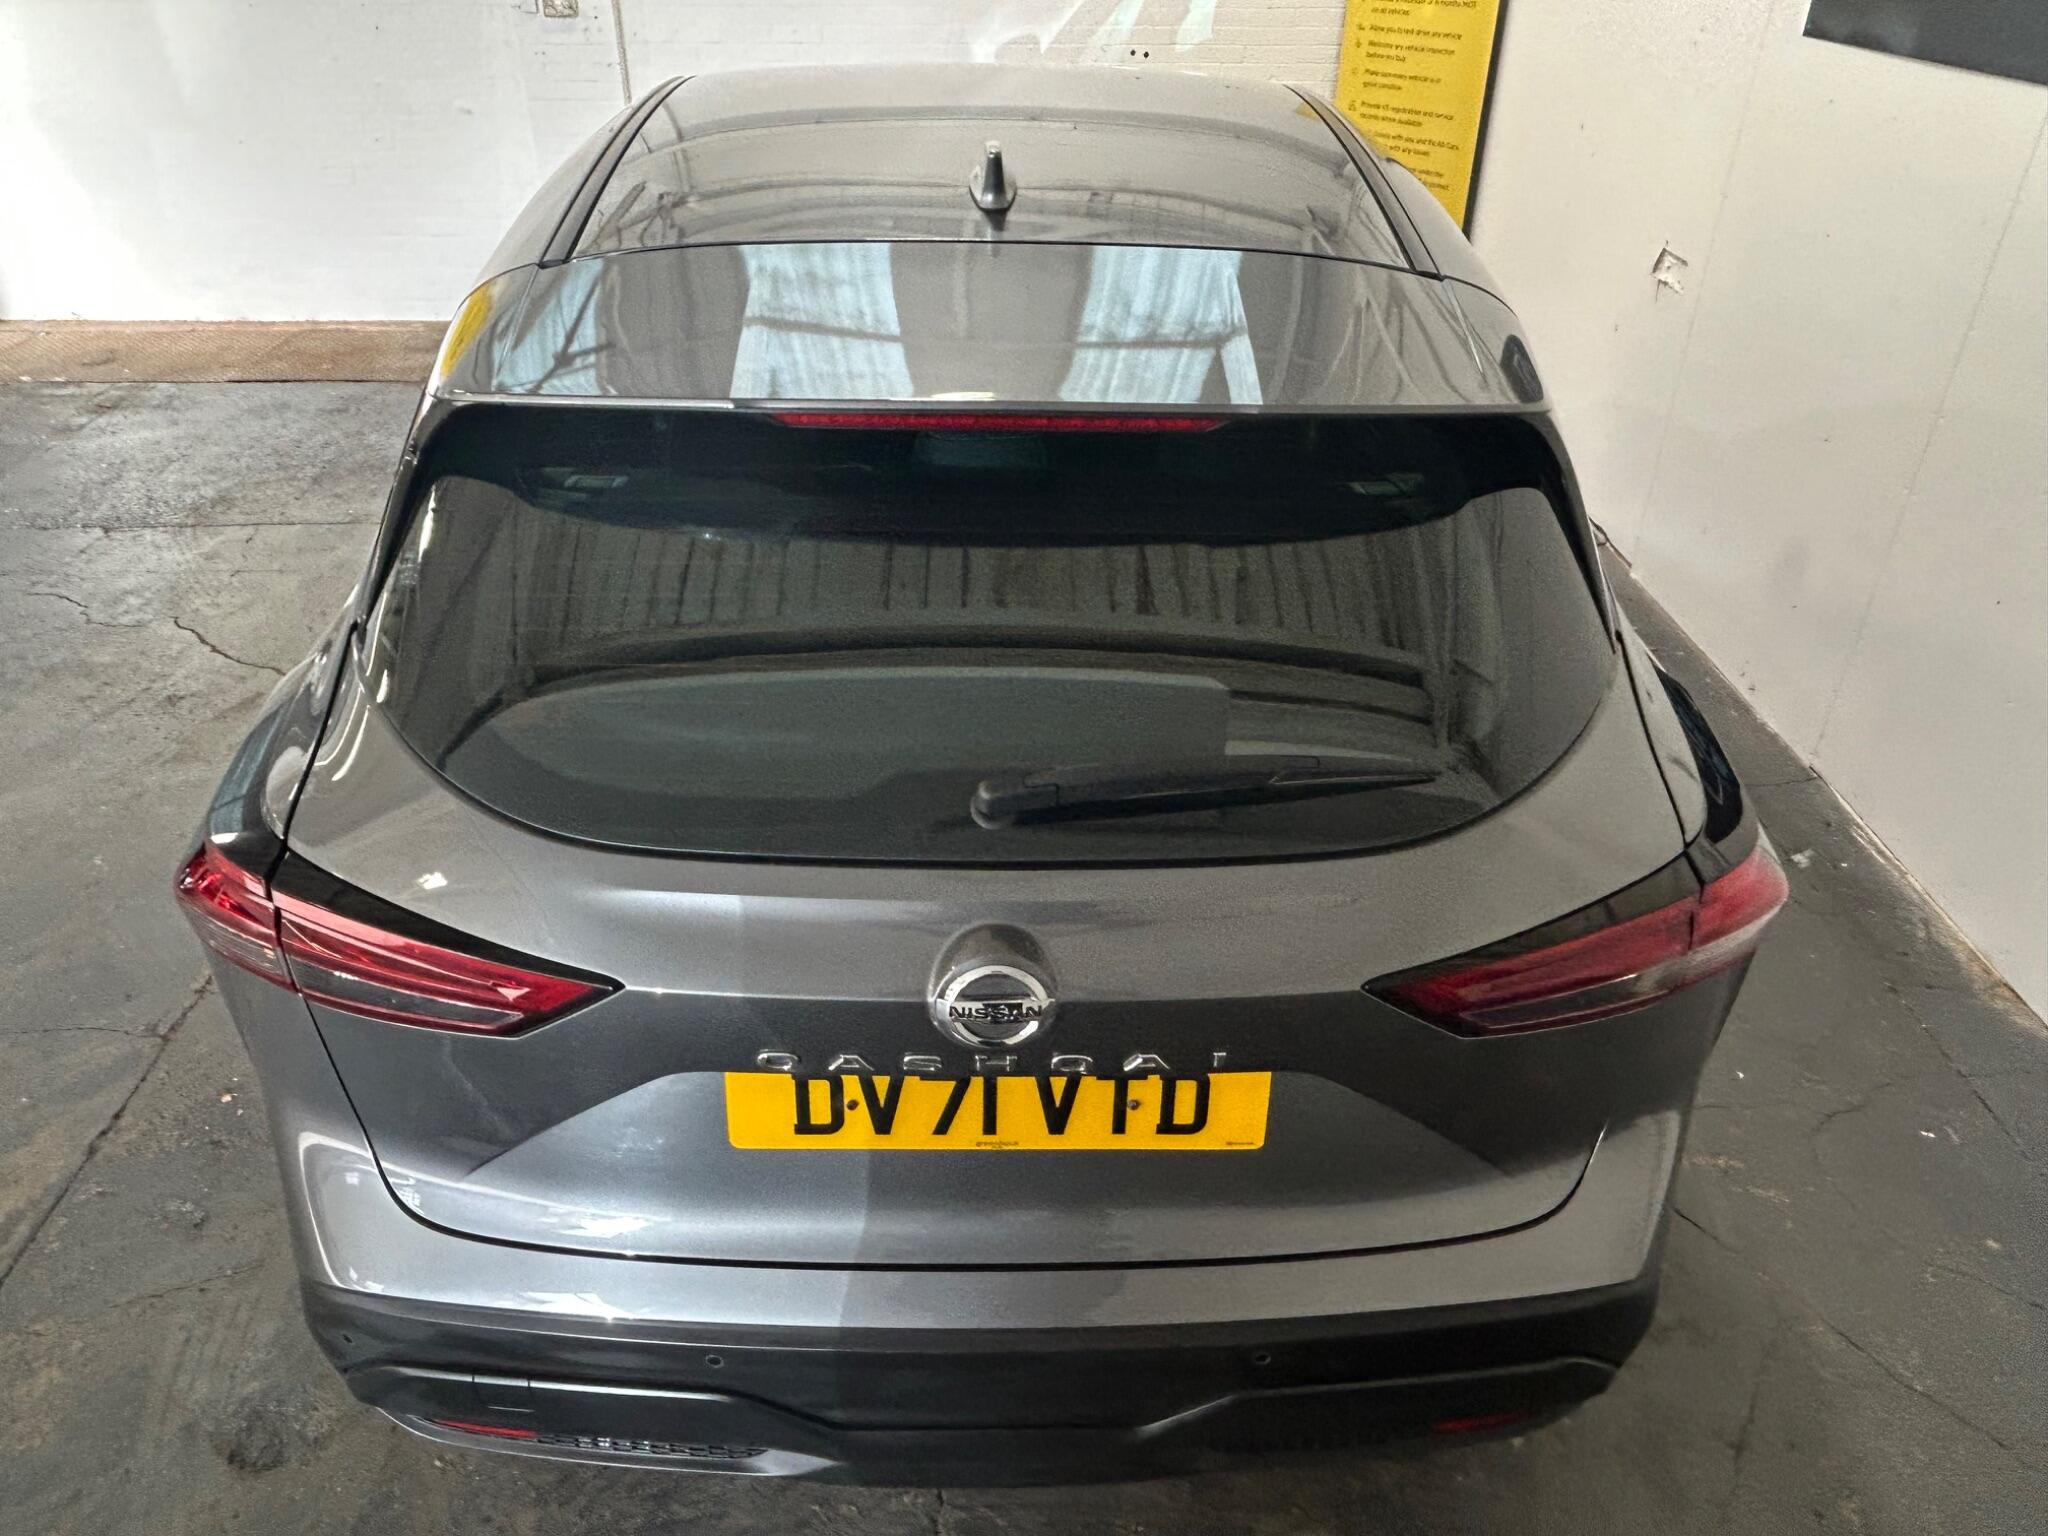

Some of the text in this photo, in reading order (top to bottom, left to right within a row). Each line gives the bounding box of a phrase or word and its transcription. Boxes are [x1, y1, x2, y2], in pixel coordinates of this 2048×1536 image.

[949, 1004, 1043, 1020] NISSAN
[756, 1048, 1229, 1072] QASHQAI
[791, 1072, 999, 1136] DV71
